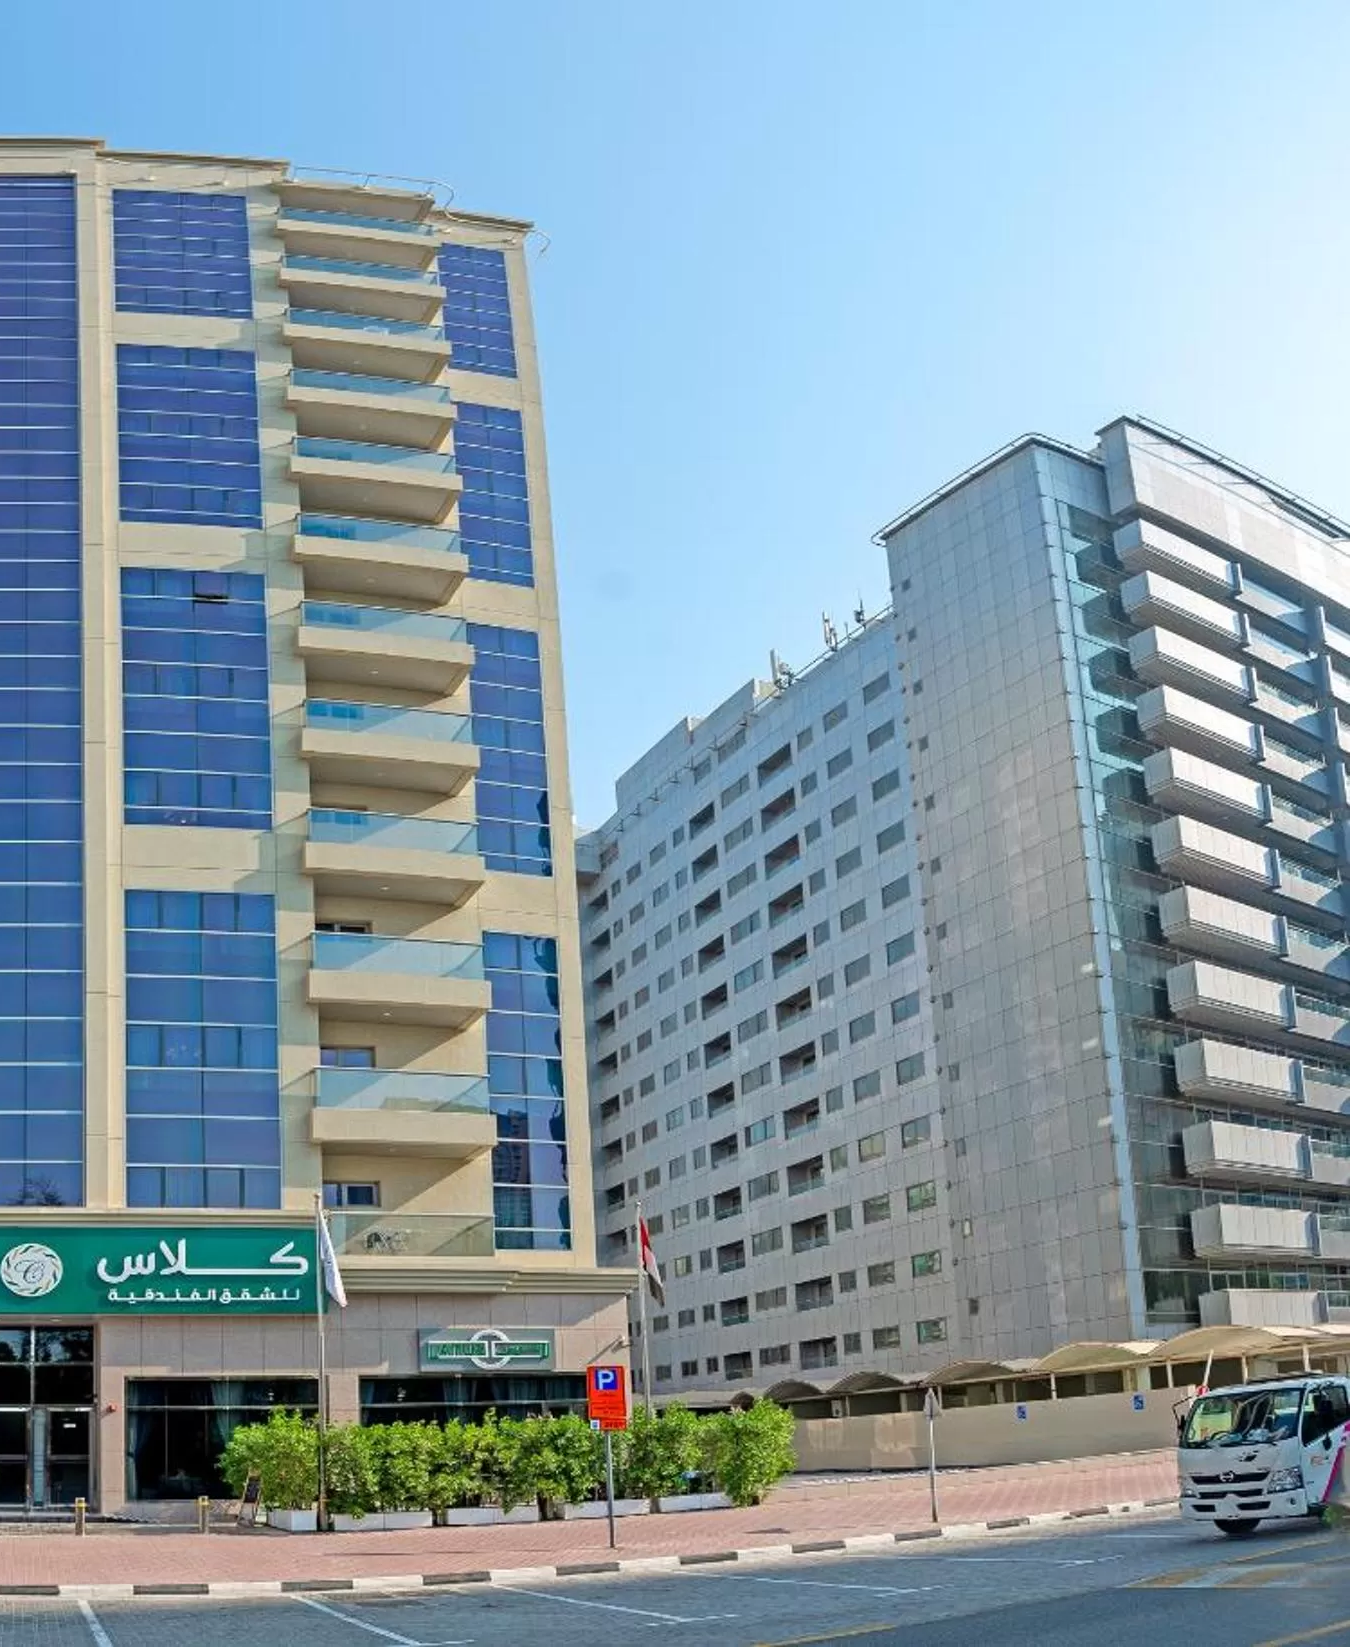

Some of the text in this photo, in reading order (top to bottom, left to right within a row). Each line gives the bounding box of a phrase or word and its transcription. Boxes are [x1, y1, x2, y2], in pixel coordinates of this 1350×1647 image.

[96, 1238, 310, 1284] كلاس
[107, 1286, 301, 1304] للشقق الفندقية
[598, 1370, 615, 1390] P
